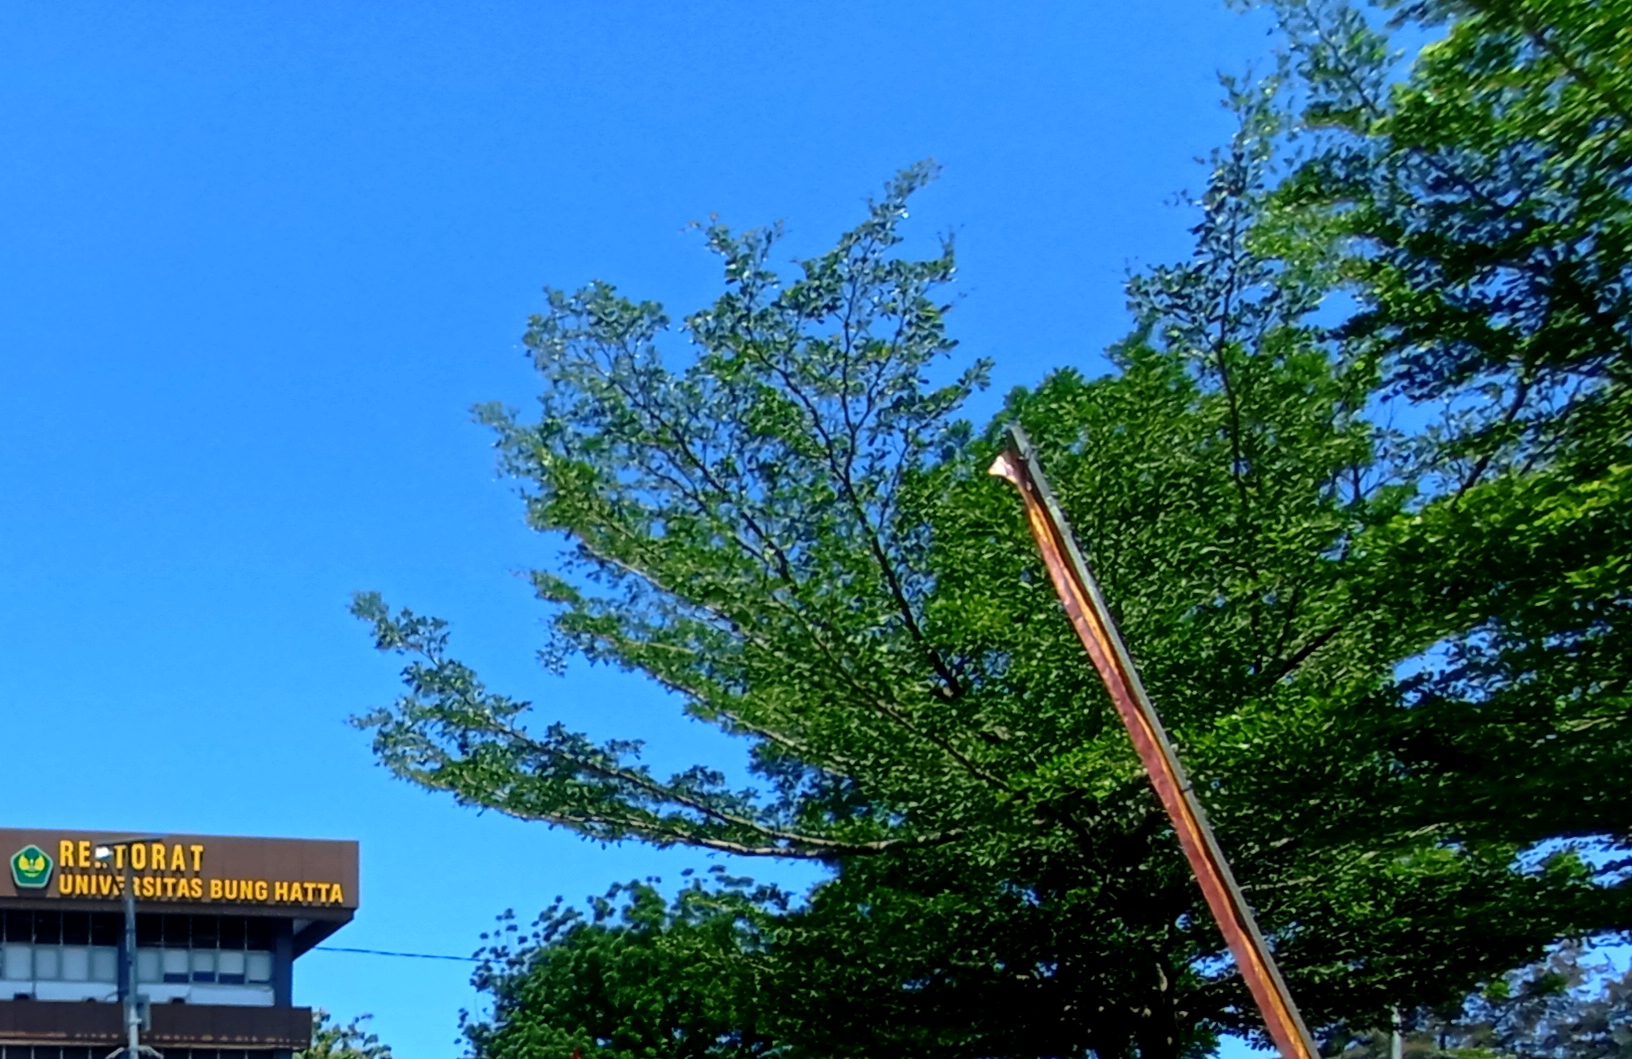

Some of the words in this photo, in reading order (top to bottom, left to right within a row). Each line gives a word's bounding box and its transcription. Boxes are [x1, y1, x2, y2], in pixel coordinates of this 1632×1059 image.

[59, 839, 204, 871] RETORAT
[210, 878, 268, 901] BUNG
[274, 880, 344, 903] HATTA
